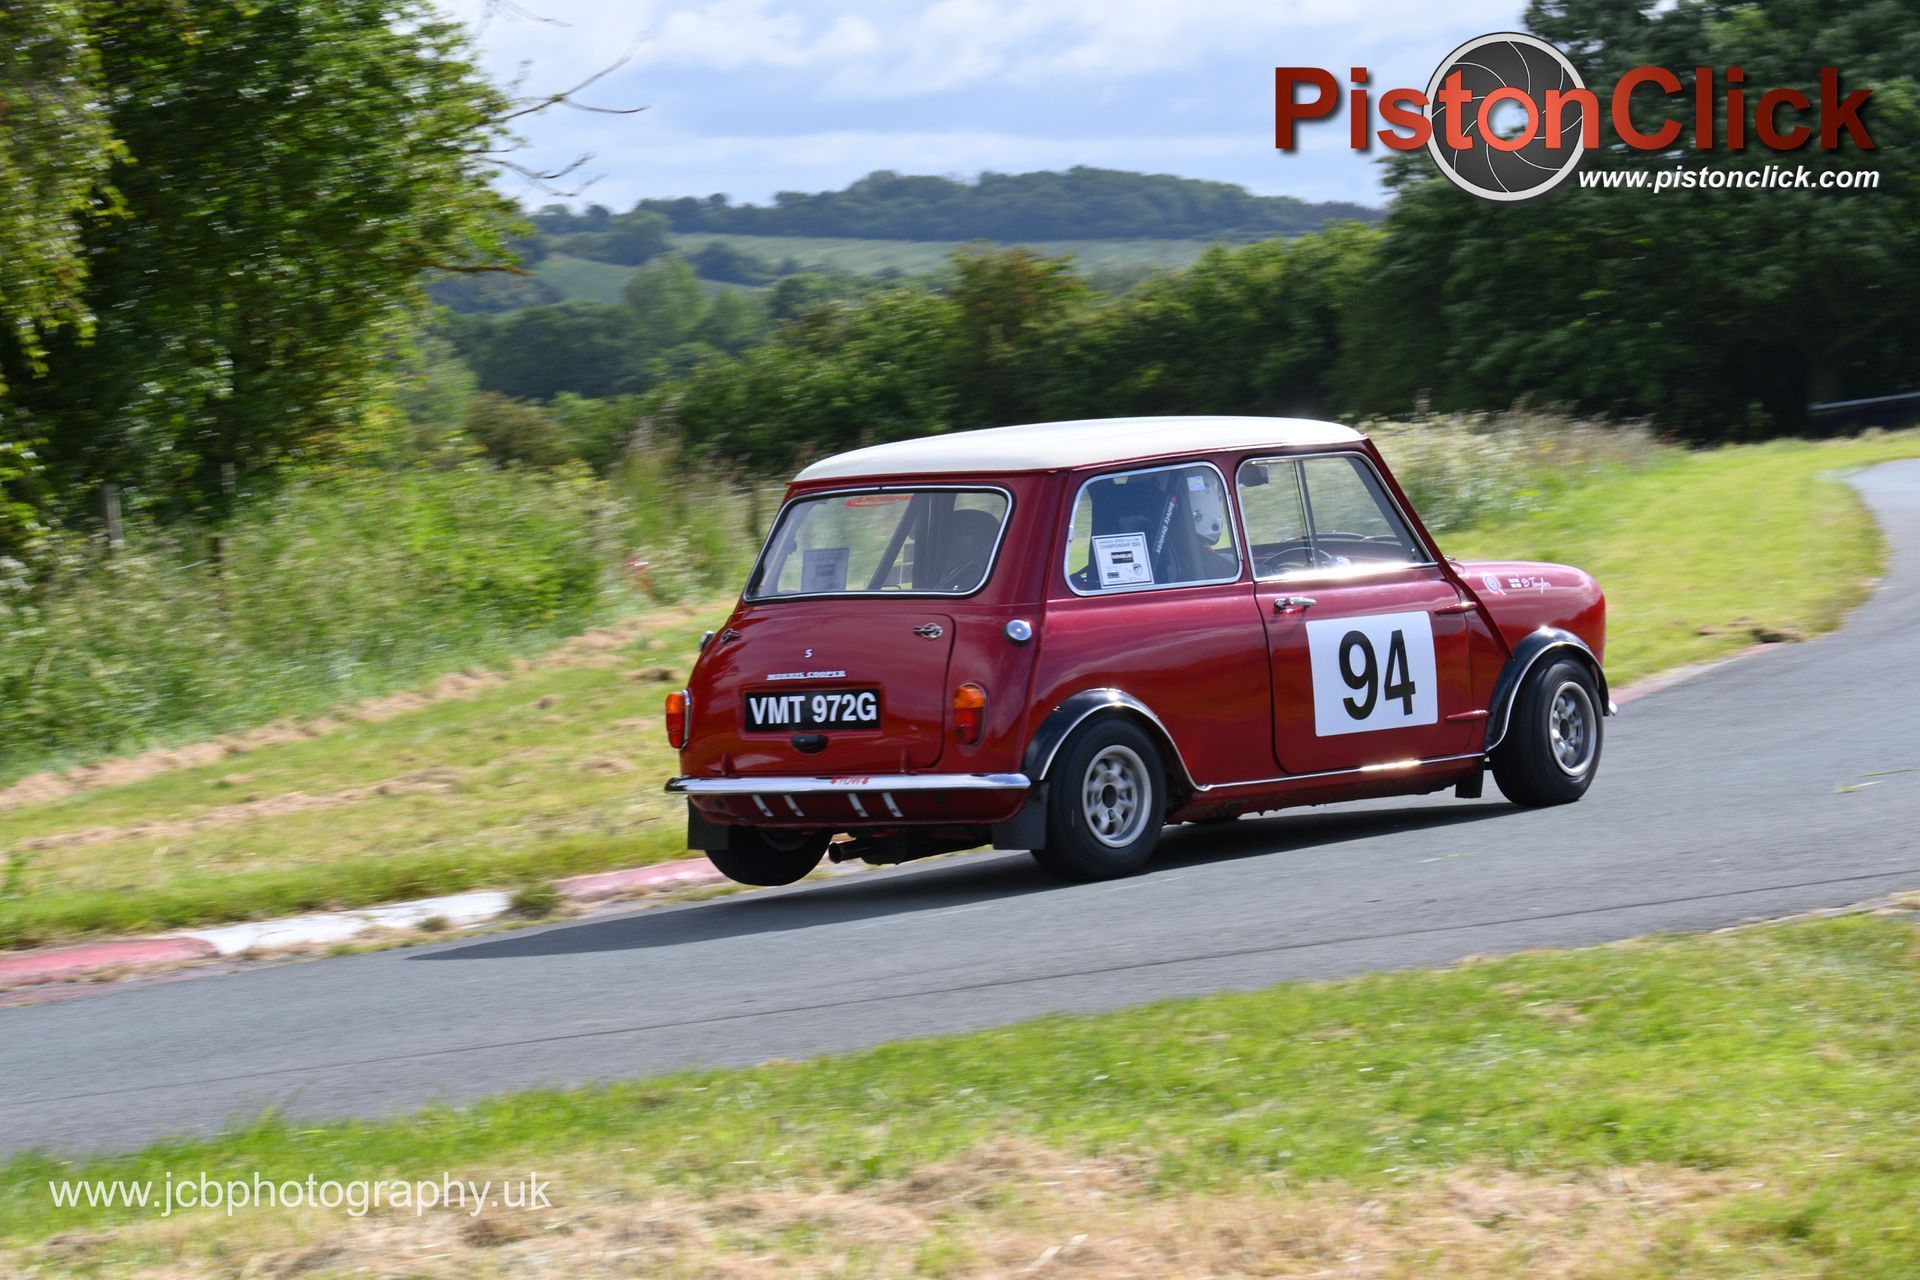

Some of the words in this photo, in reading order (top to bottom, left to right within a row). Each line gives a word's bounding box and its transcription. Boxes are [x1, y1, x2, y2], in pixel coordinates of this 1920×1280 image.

[804, 648, 813, 658] S
[1339, 629, 1416, 720] 94
[749, 695, 806, 726] VMT
[811, 691, 878, 724] 972G
